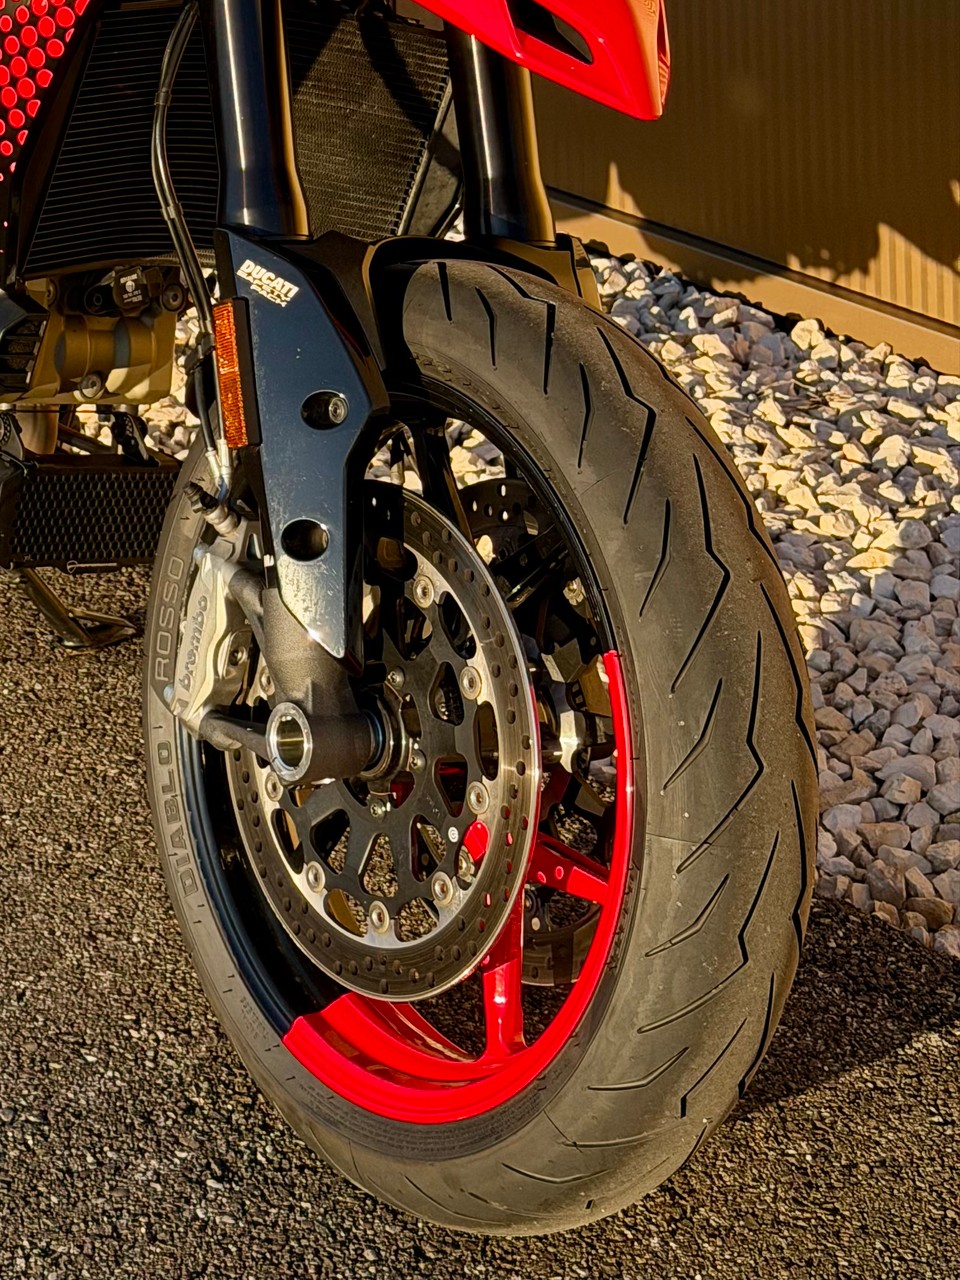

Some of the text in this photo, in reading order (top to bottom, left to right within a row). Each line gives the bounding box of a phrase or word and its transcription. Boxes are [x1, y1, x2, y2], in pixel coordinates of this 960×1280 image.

[240, 259, 300, 299] DUCATI
[155, 557, 184, 681] ROSSO
[178, 594, 208, 693] brembo
[157, 740, 198, 897] DIABLO
